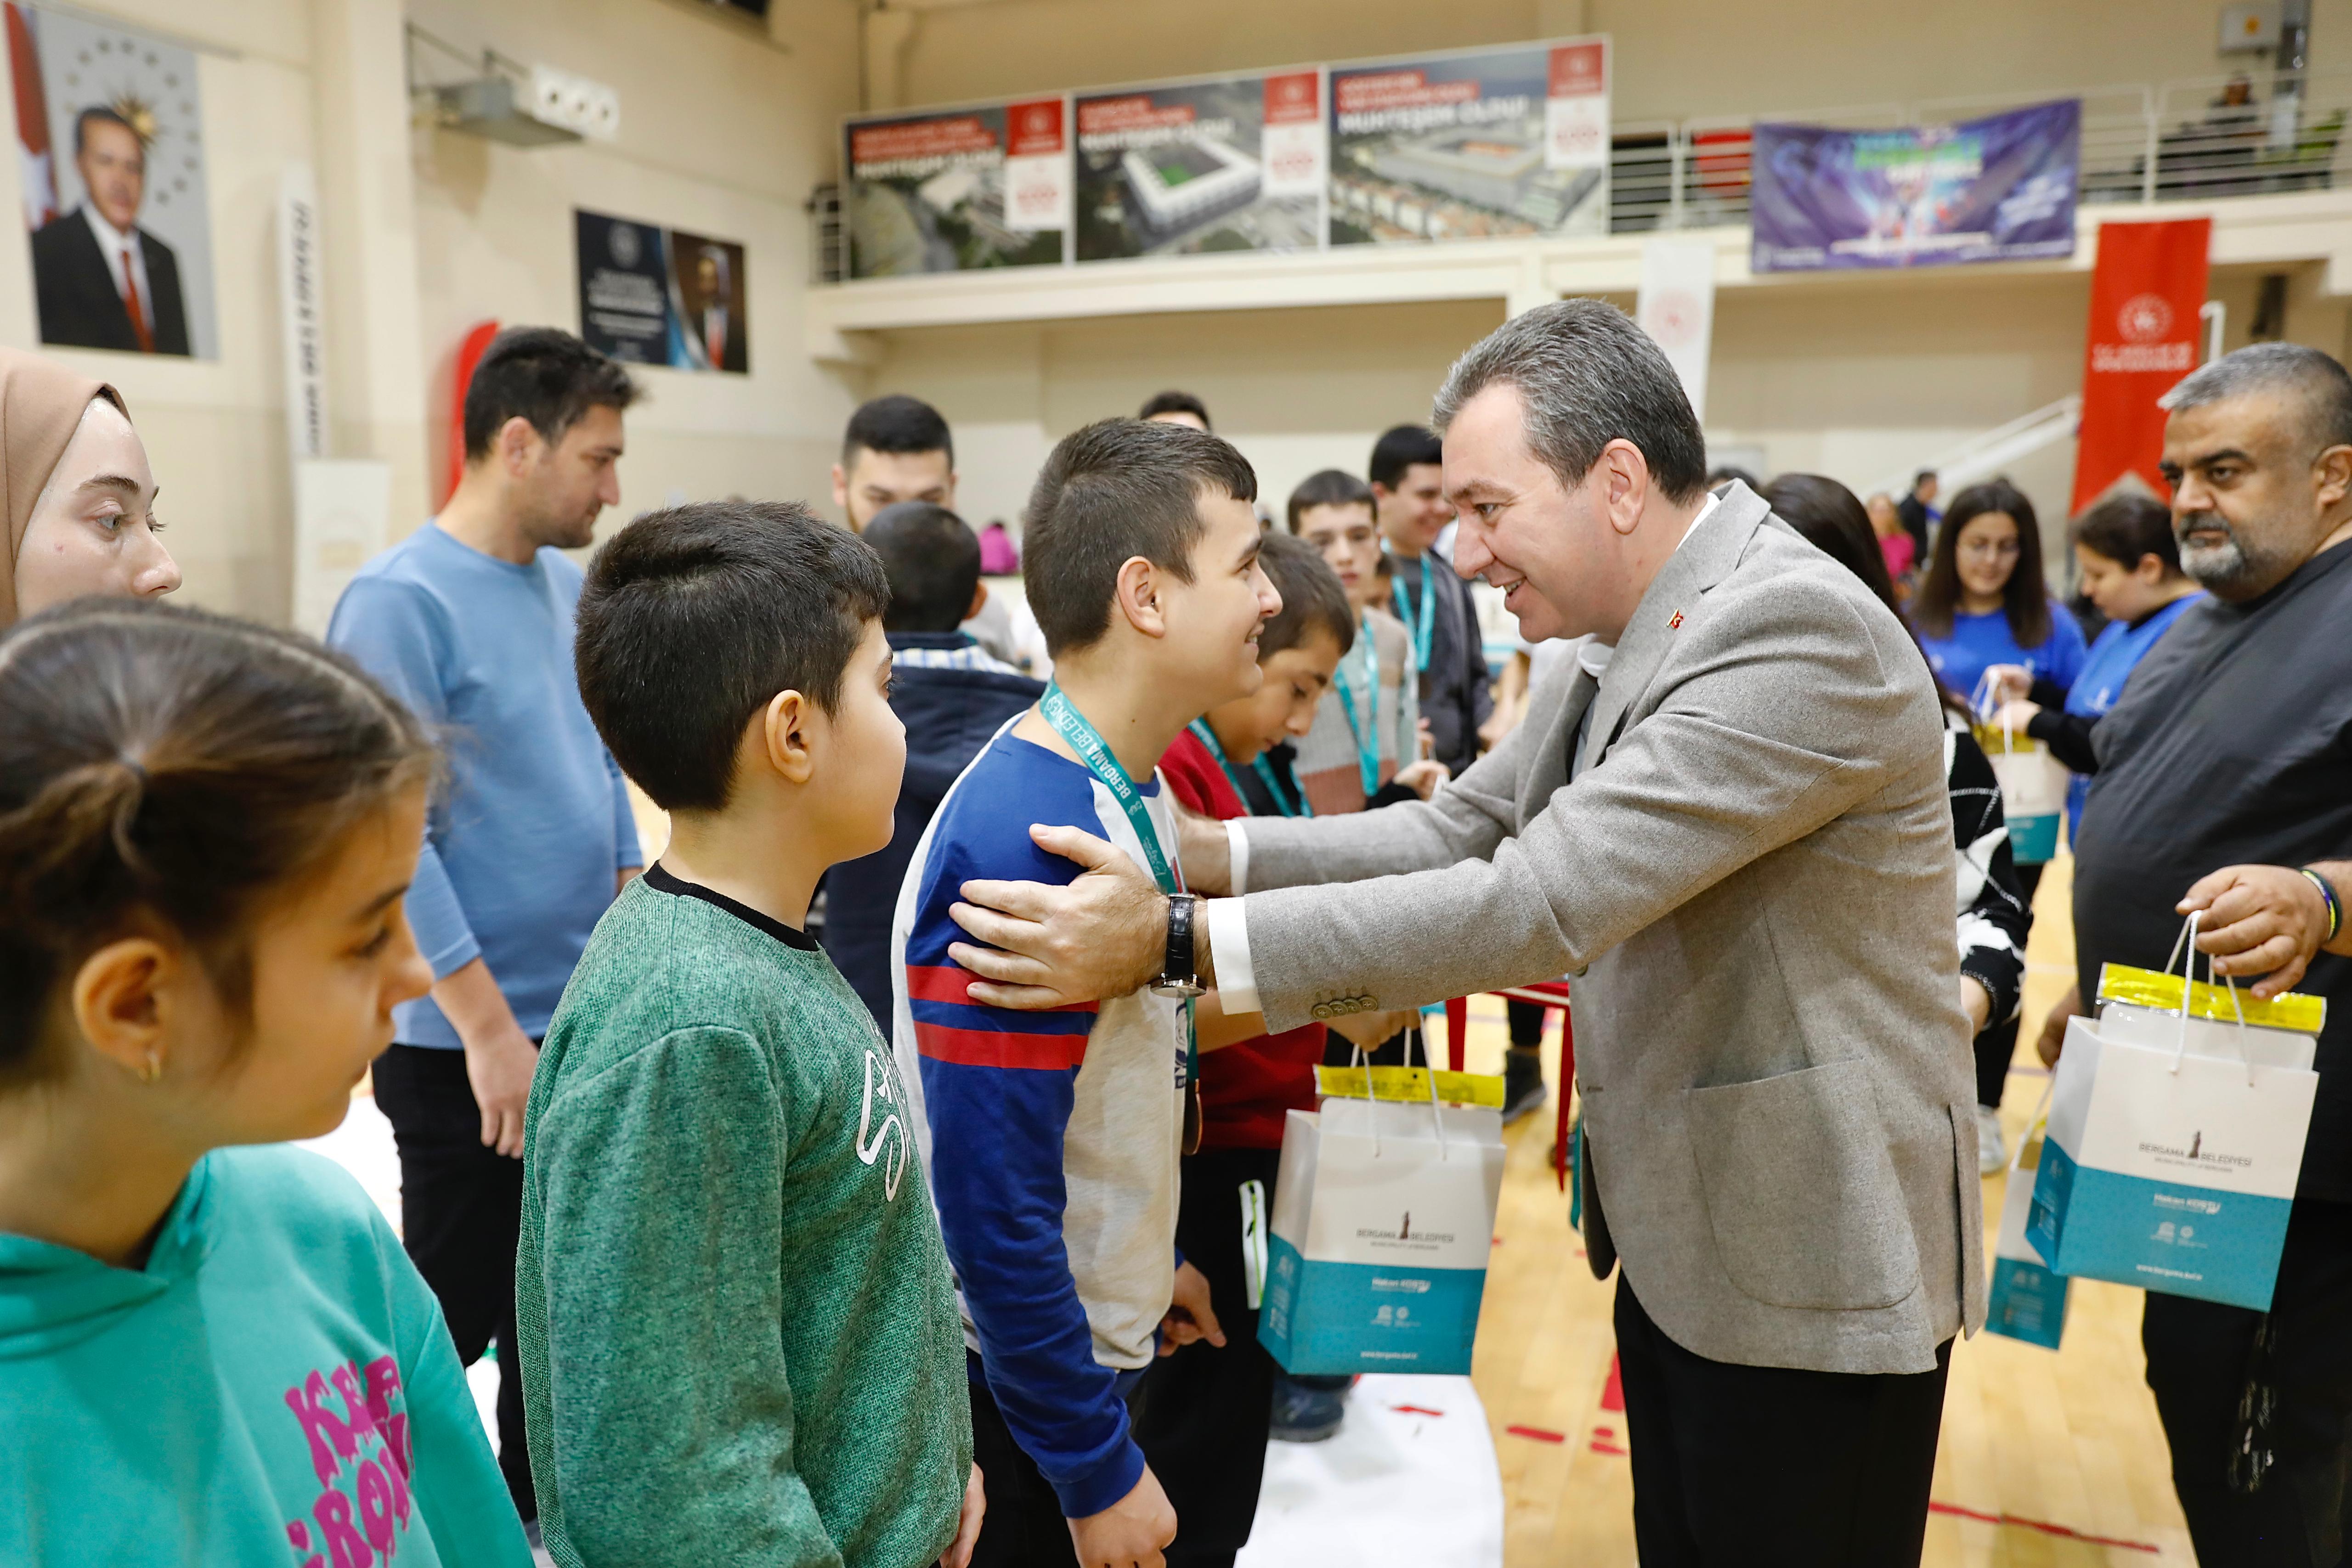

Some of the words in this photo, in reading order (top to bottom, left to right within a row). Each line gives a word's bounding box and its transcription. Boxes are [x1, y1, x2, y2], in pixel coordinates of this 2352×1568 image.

[1086, 742, 1132, 800] BERGAMA
[2139, 1142, 2185, 1156] BERGAMA
[1356, 1227, 1396, 1239] BERGAMA
